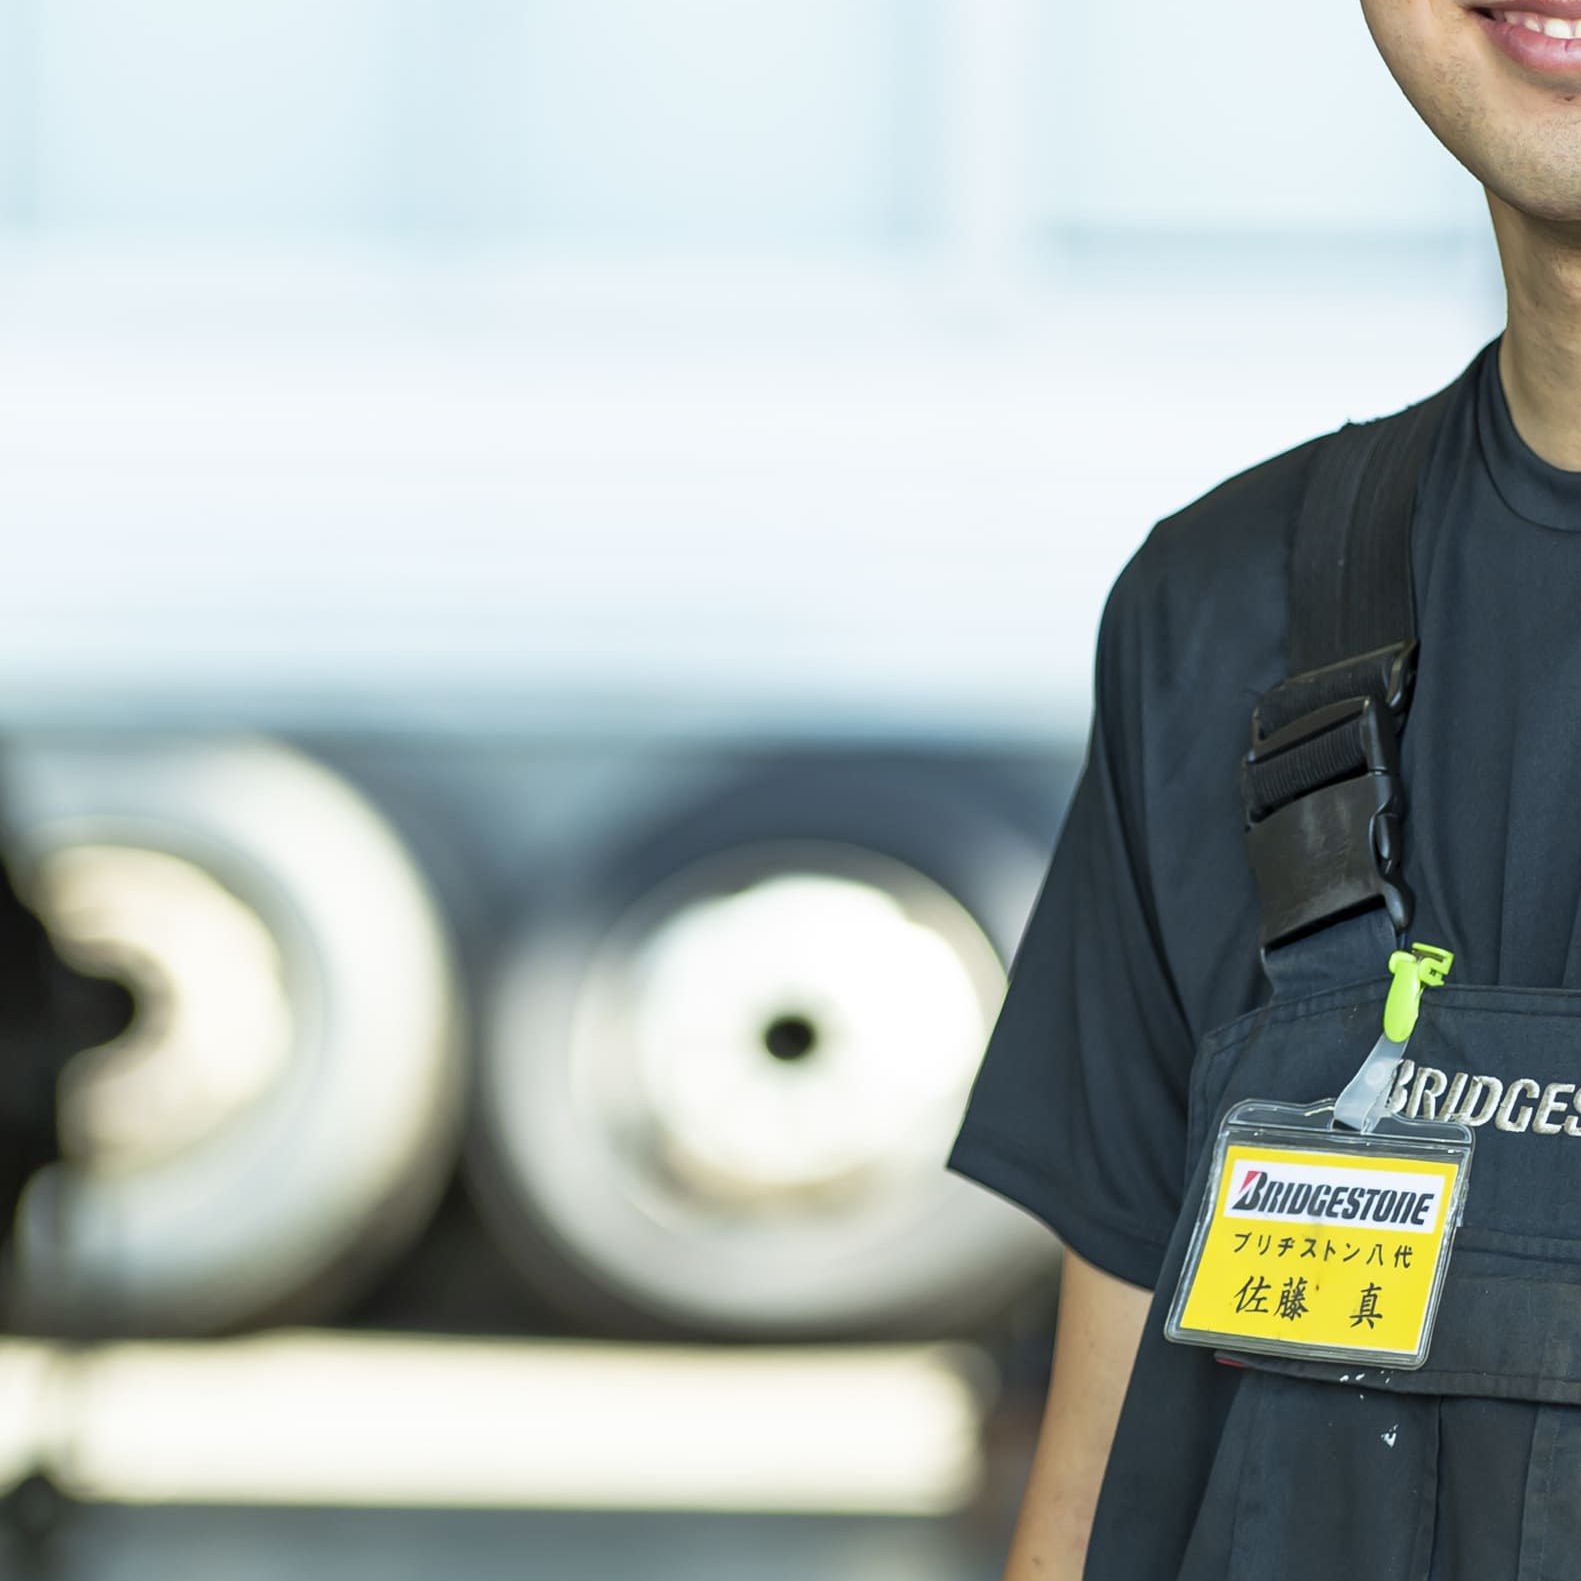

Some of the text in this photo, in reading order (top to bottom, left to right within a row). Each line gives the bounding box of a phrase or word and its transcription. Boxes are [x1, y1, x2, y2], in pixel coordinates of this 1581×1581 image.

[1232, 1171, 1434, 1225] BRIDGESTONE
[1234, 1276, 1383, 1329] 佐藤 真
